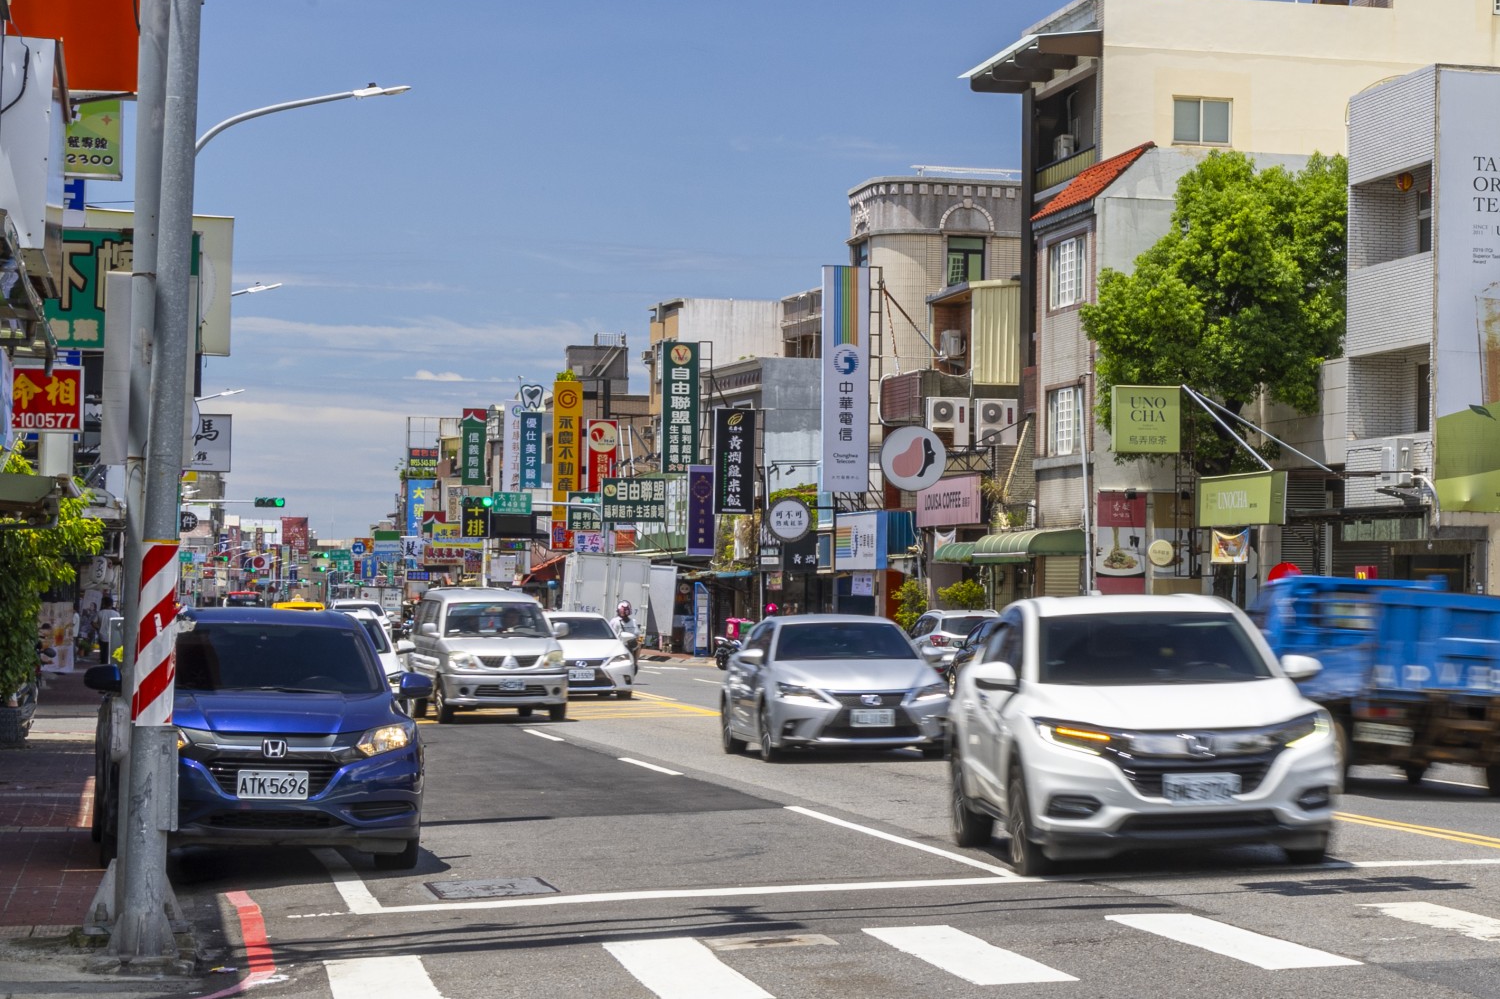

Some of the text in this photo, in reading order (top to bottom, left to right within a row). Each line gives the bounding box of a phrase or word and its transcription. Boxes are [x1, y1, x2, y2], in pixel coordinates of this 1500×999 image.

[66, 153, 113, 167] 2300
[671, 367, 691, 424] 自由聯盟
[1130, 396, 1166, 409] UNO
[839, 381, 854, 441] 中華電信
[1130, 410, 1166, 422] CHA
[557, 415, 574, 492] 永慶不動產
[669, 425, 679, 463] 生活廣場
[681, 425, 692, 463] 福利超市
[468, 432, 480, 479] 信義房屋
[617, 480, 665, 501] 自由聯盟
[925, 491, 961, 511] LOUISA COFFEE
[1217, 490, 1248, 509] UNOCHA
[776, 510, 803, 519] 可不可
[239, 776, 307, 797] ATK-5696
